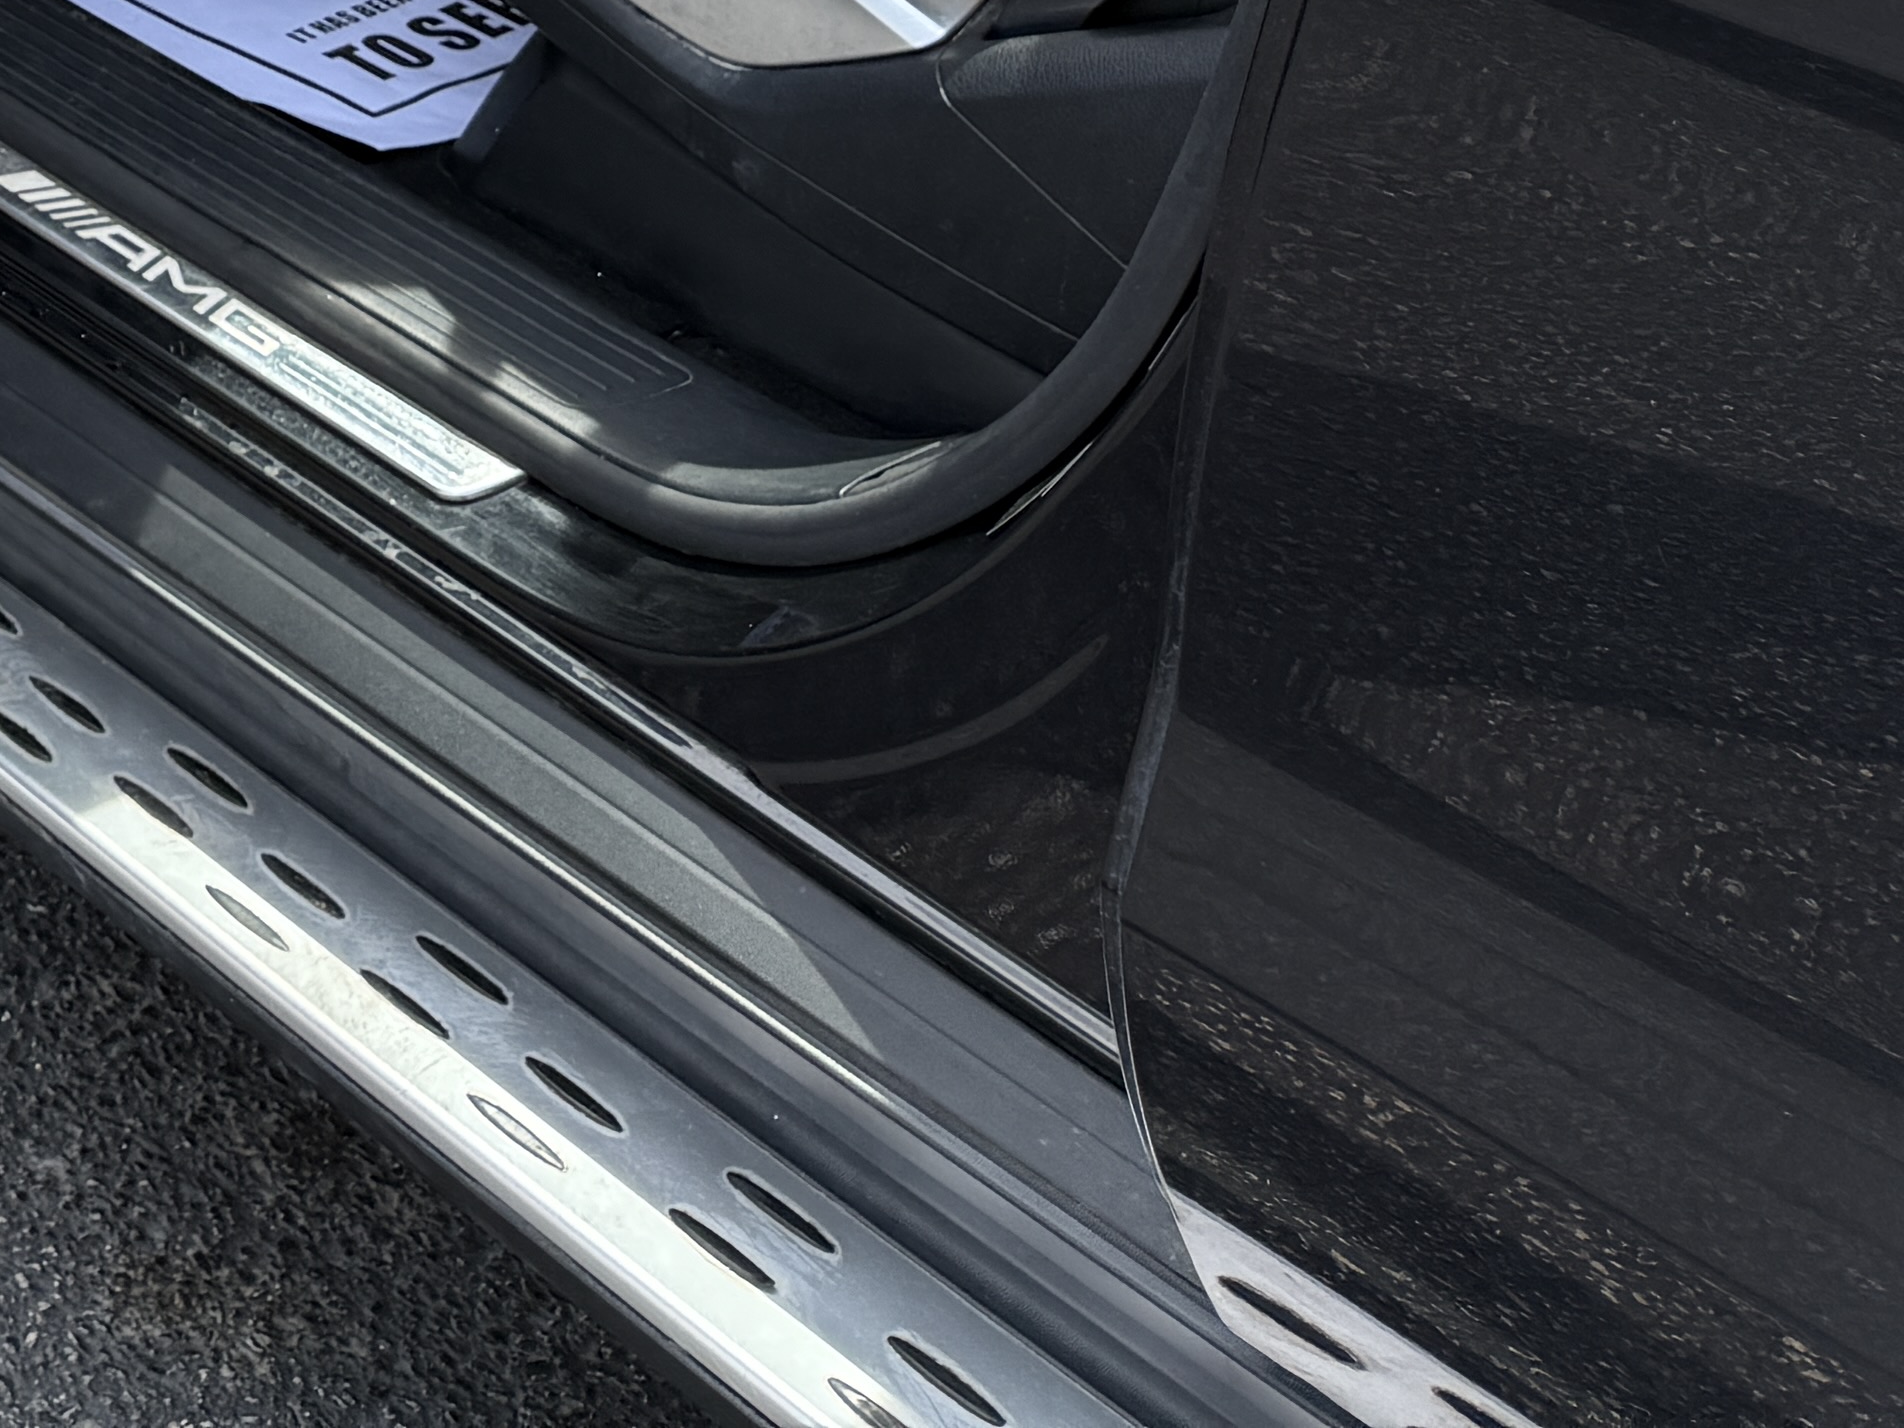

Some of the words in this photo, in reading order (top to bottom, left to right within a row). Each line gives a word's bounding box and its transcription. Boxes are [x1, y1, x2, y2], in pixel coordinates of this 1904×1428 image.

[285, 26, 317, 43] IT
[308, 10, 361, 35] HAS
[321, 34, 435, 81] TO
[77, 223, 281, 357] AMG
